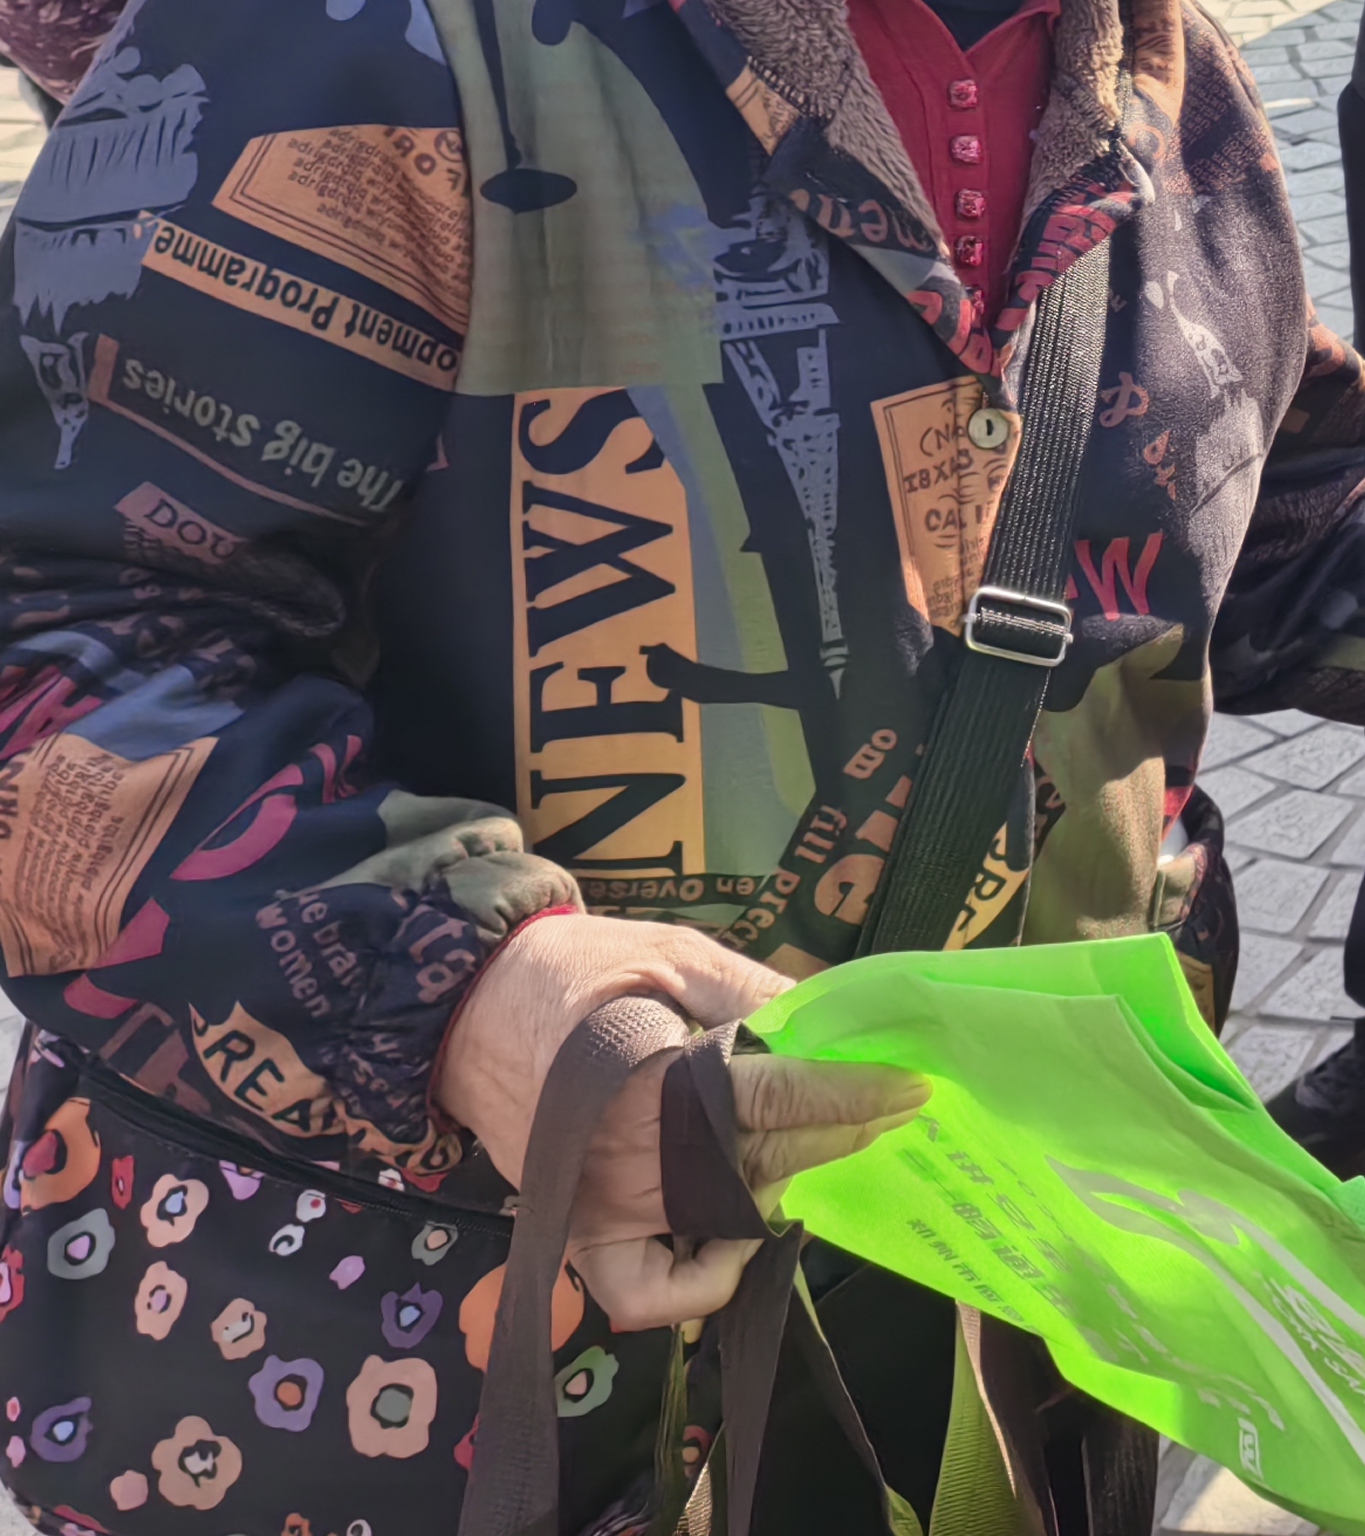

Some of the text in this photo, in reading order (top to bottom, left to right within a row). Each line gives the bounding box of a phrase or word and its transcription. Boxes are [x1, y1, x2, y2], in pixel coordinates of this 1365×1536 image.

[153, 224, 339, 333] Programme
[259, 419, 334, 486] big
[337, 455, 404, 513] The
[517, 389, 690, 877] NEWS
